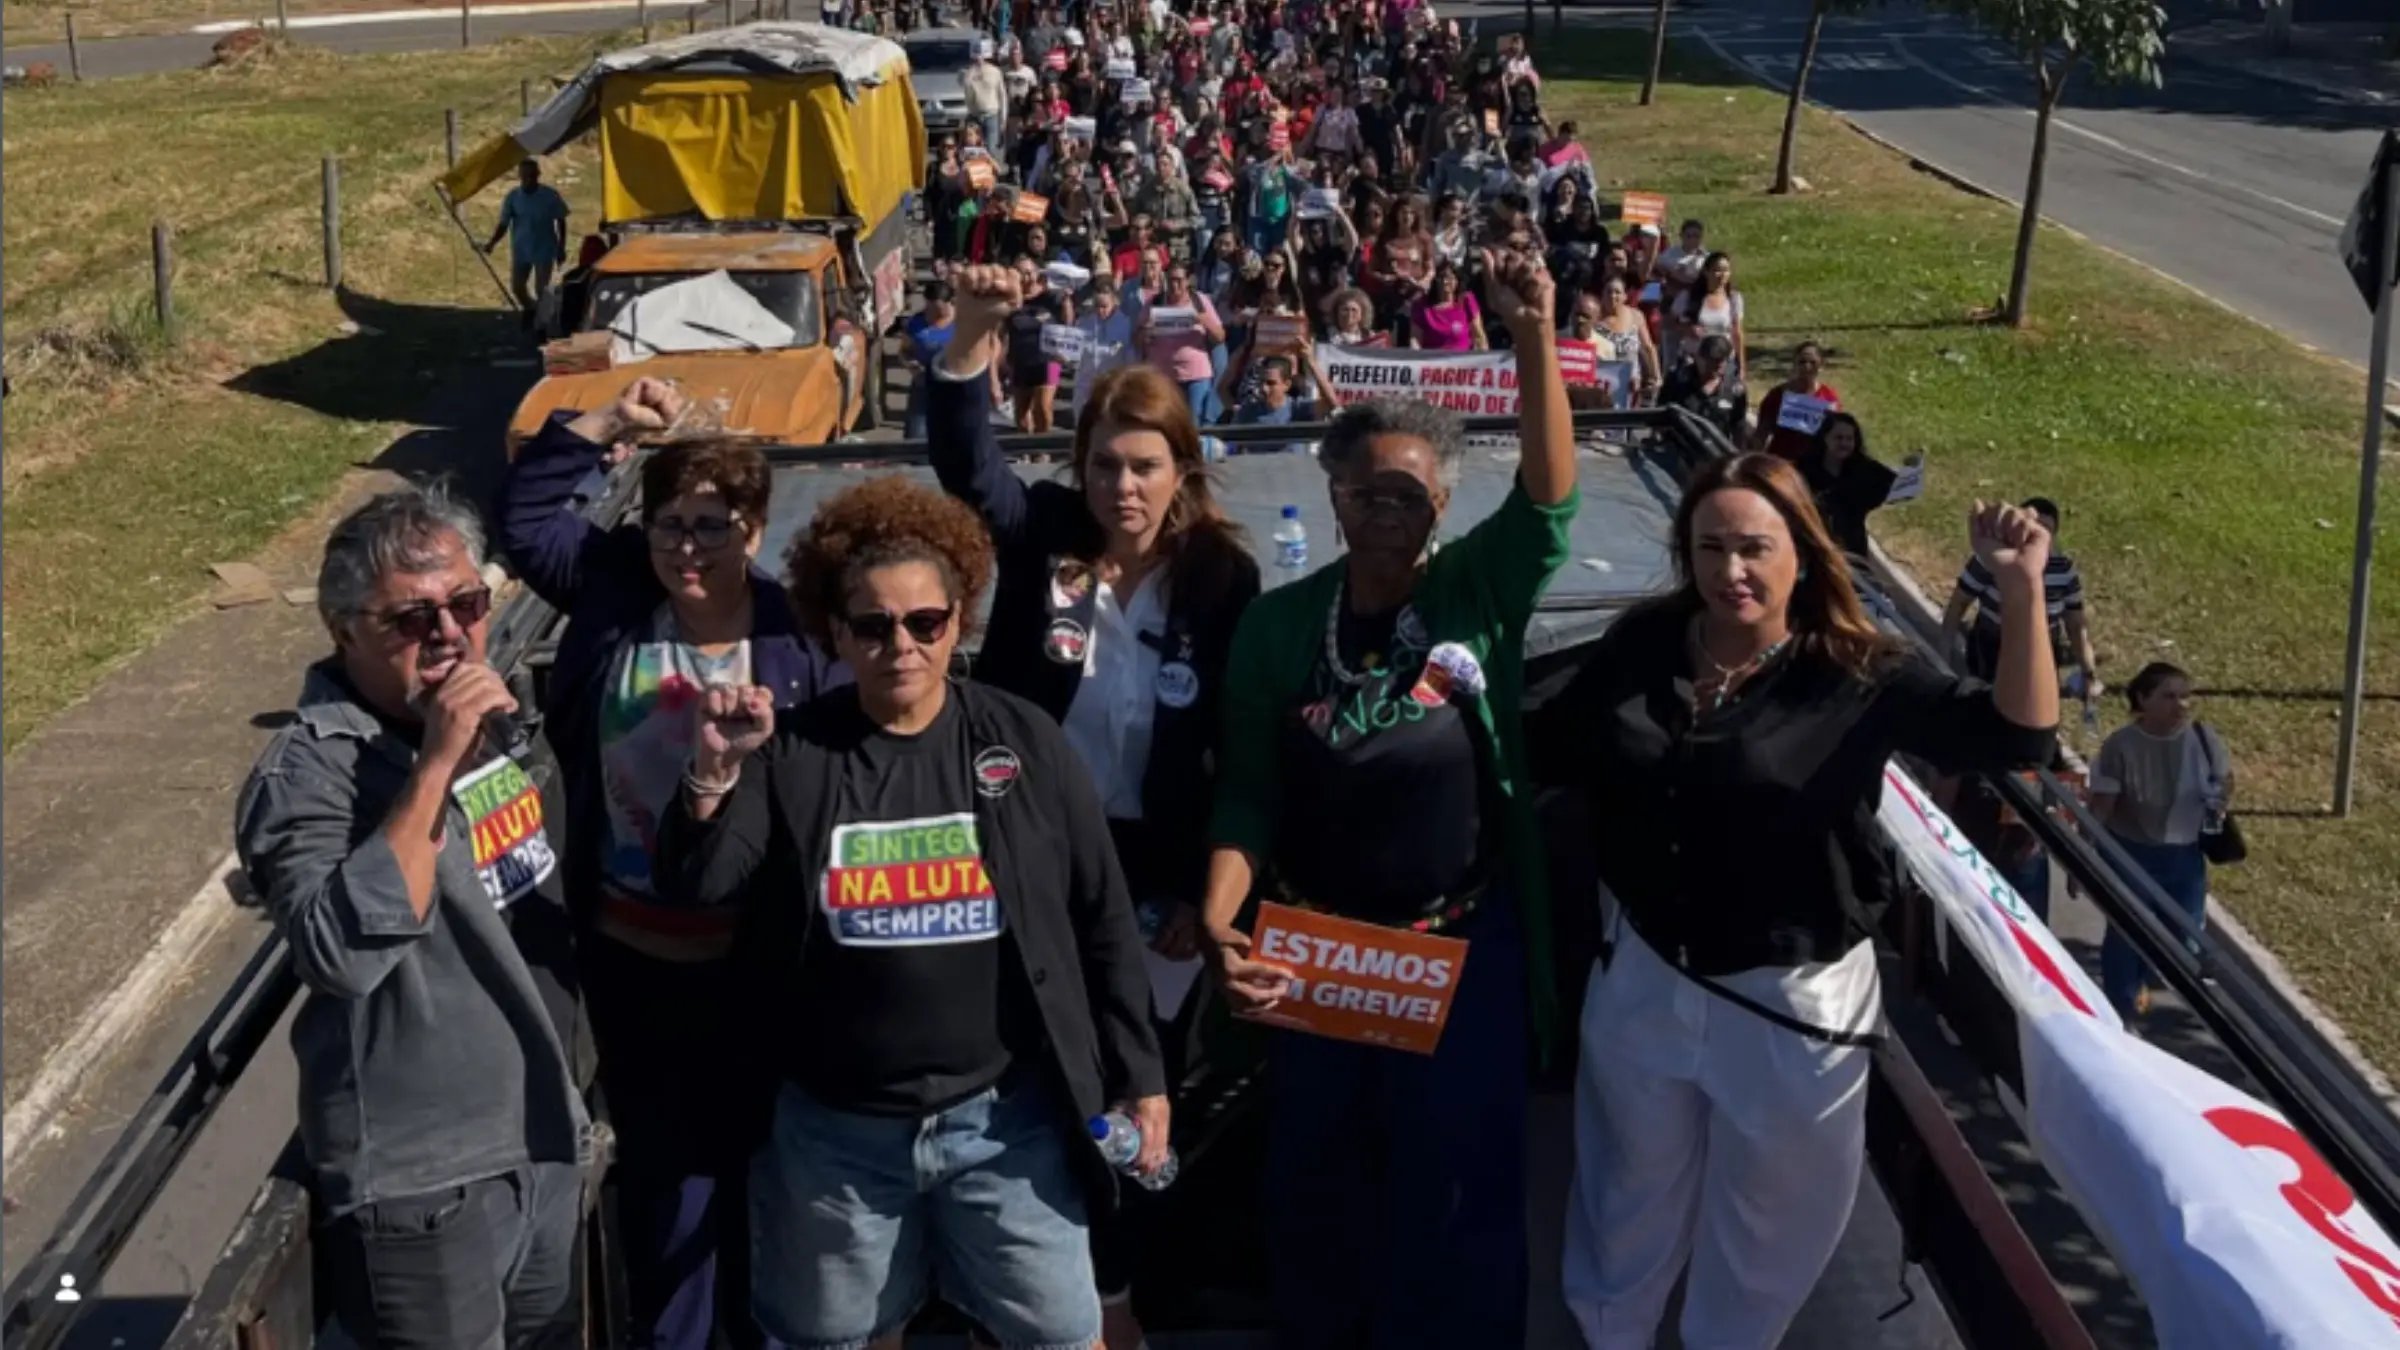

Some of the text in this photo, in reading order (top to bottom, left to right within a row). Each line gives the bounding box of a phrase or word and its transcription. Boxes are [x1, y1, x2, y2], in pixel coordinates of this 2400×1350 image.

[1419, 366, 1478, 387] PAGUE
[1485, 394, 1508, 414] DE
[839, 869, 893, 905] NA
[851, 899, 994, 936] SEMPRE!
[1260, 926, 1452, 989] ESTAMOS
[1312, 982, 1443, 1024] GREVE!
